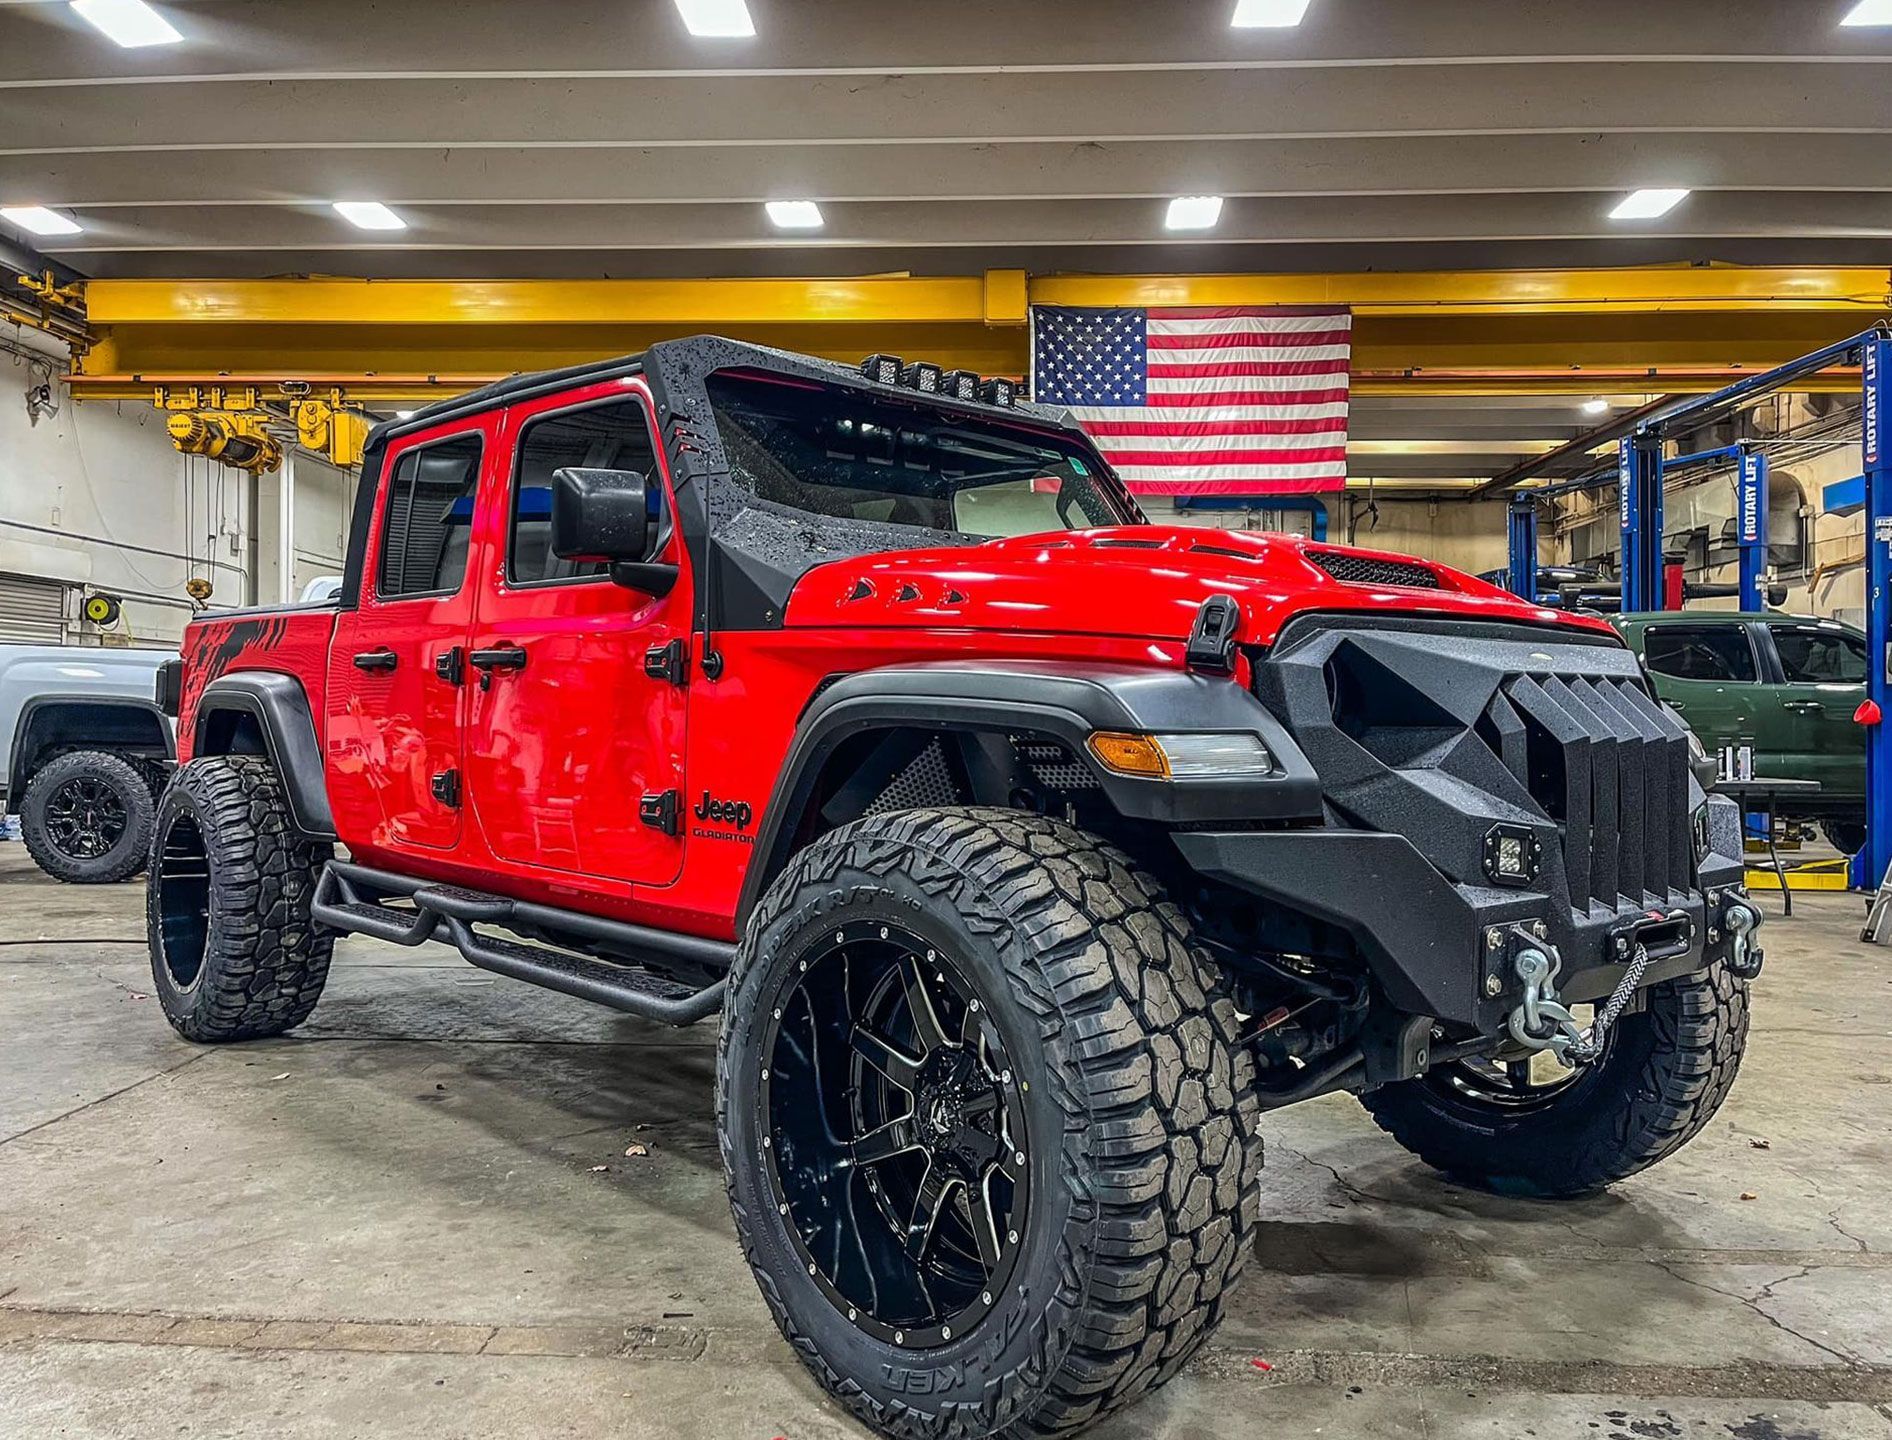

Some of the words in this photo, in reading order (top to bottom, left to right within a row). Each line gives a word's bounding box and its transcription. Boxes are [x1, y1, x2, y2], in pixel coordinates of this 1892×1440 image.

[1866, 344, 1876, 381] LIFT
[1018, 385, 1025, 395] 5
[1866, 385, 1877, 454] ROTARY
[1745, 456, 1757, 482] LIFT
[1621, 469, 1629, 521] ROTARY
[1744, 485, 1757, 534] ROTARY
[1873, 586, 1880, 598] 3
[694, 790, 752, 830] Jeep
[693, 827, 756, 844] GLADIATOR
